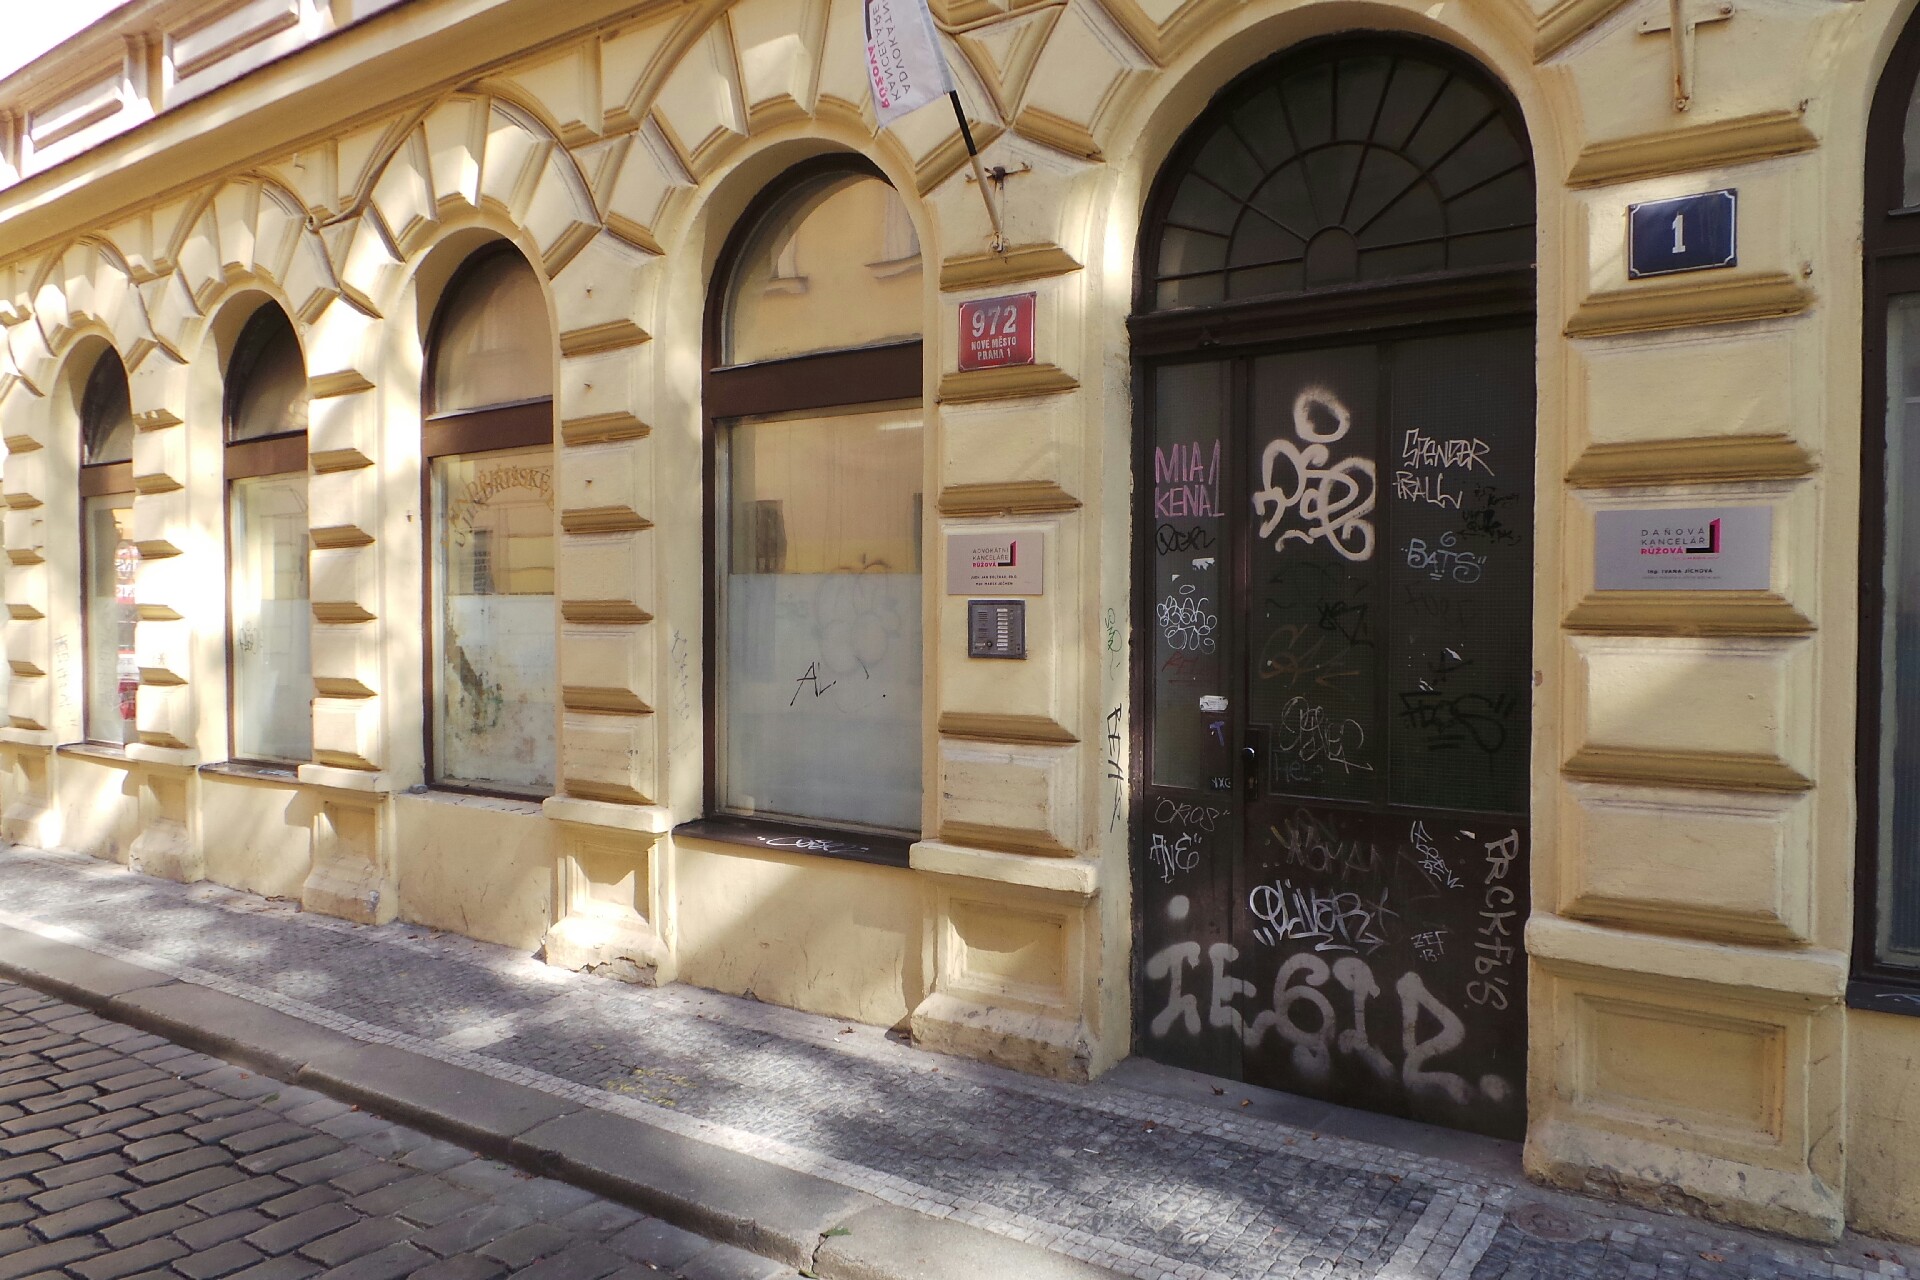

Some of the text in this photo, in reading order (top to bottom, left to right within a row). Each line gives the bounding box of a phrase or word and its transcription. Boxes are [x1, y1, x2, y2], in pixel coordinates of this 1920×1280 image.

[1671, 210, 1686, 254] 1
[972, 305, 1017, 337] 972
[992, 336, 1016, 348] MĚSTO
[977, 348, 1011, 360] PRAHA 1
[1641, 527, 1705, 537] DAŇOVÁ
[1641, 536, 1706, 546] KANCELÁŘ
[1640, 545, 1684, 555] RŮŽOVÁ
